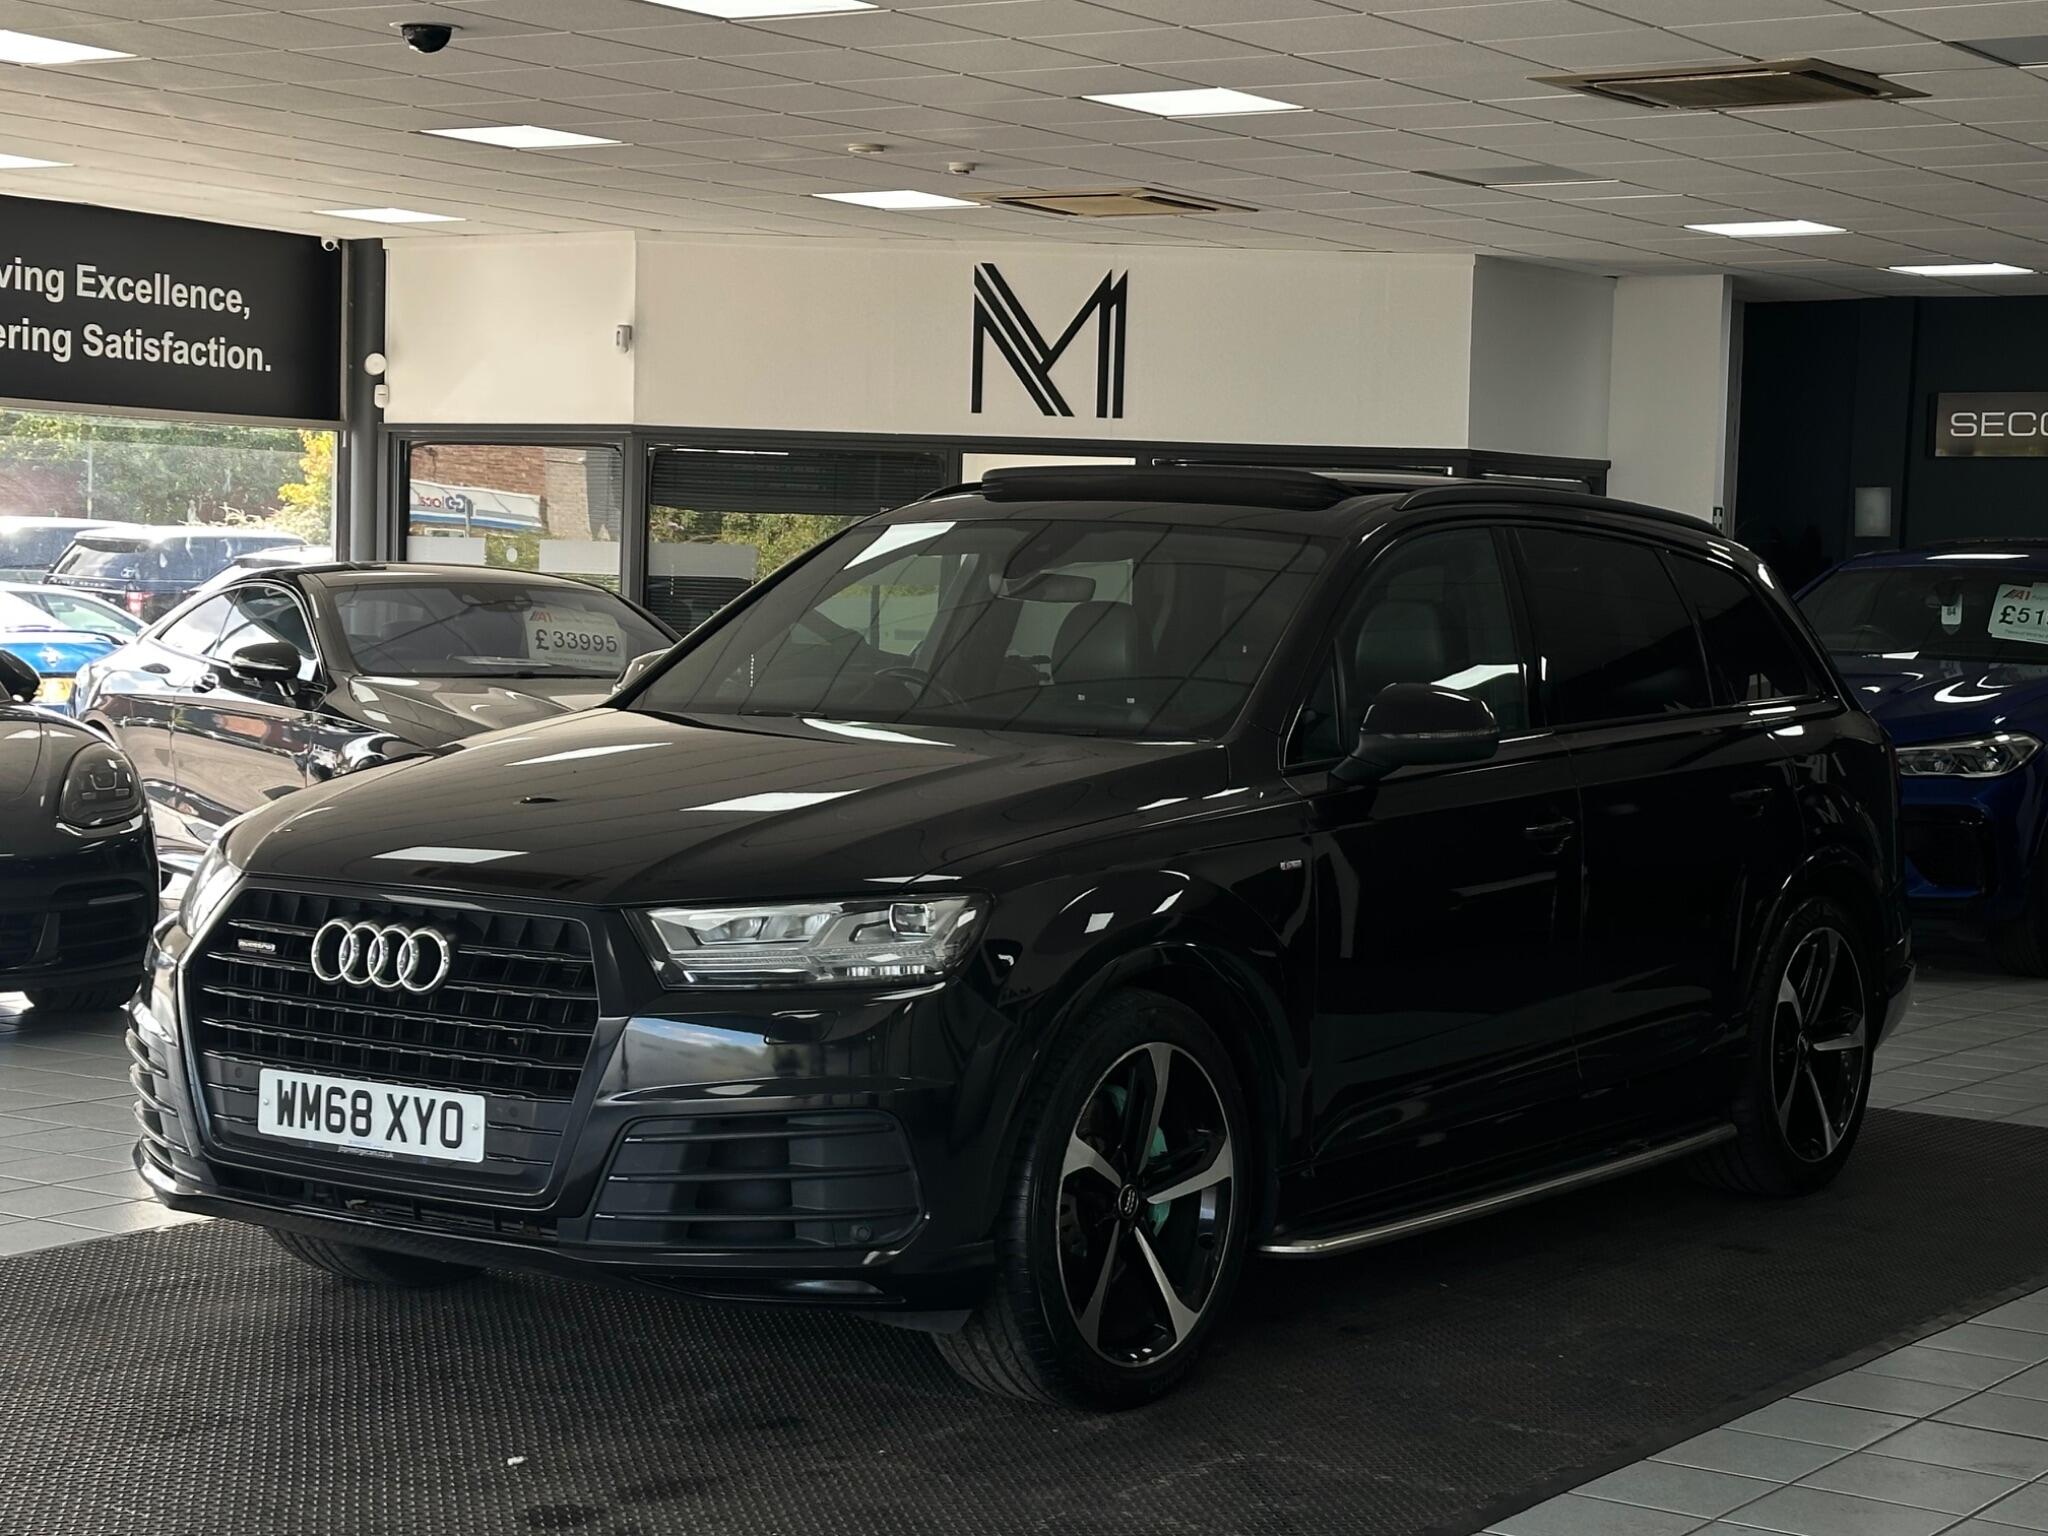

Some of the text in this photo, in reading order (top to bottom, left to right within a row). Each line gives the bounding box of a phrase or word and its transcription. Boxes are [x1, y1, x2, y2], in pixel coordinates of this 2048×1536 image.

[76, 263, 250, 320] Excellence,
[82, 323, 271, 372] Satisfaction.
[1999, 605, 2048, 626] £51
[535, 628, 618, 653] £33995
[276, 1079, 373, 1137] WM68
